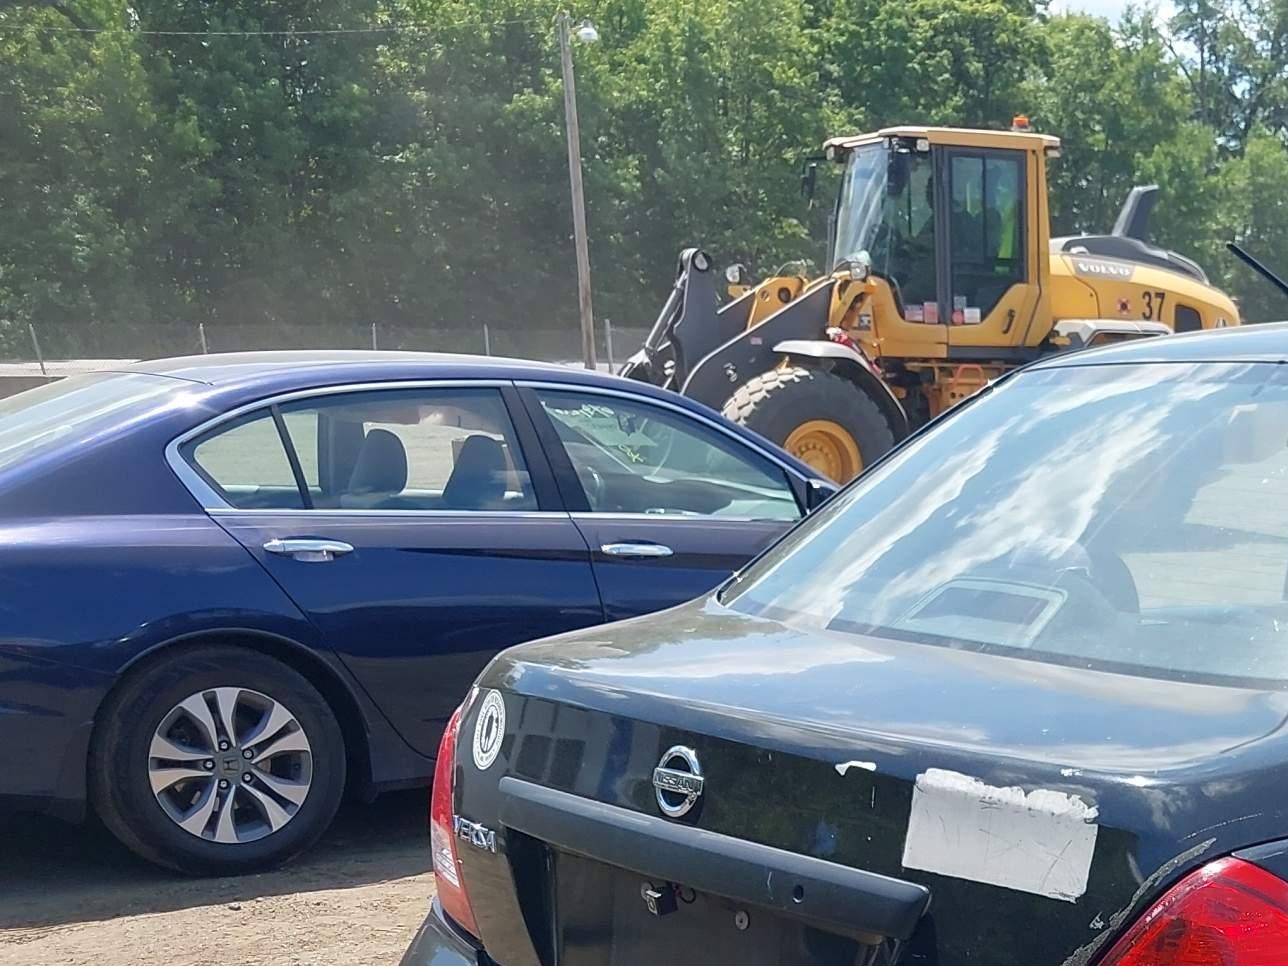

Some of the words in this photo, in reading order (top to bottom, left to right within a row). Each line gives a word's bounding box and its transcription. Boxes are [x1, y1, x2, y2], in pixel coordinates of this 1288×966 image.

[1078, 262, 1130, 277] VOLVO
[1141, 291, 1166, 321] 37
[654, 770, 702, 793] NISSAN
[452, 814, 497, 853] VERSA
